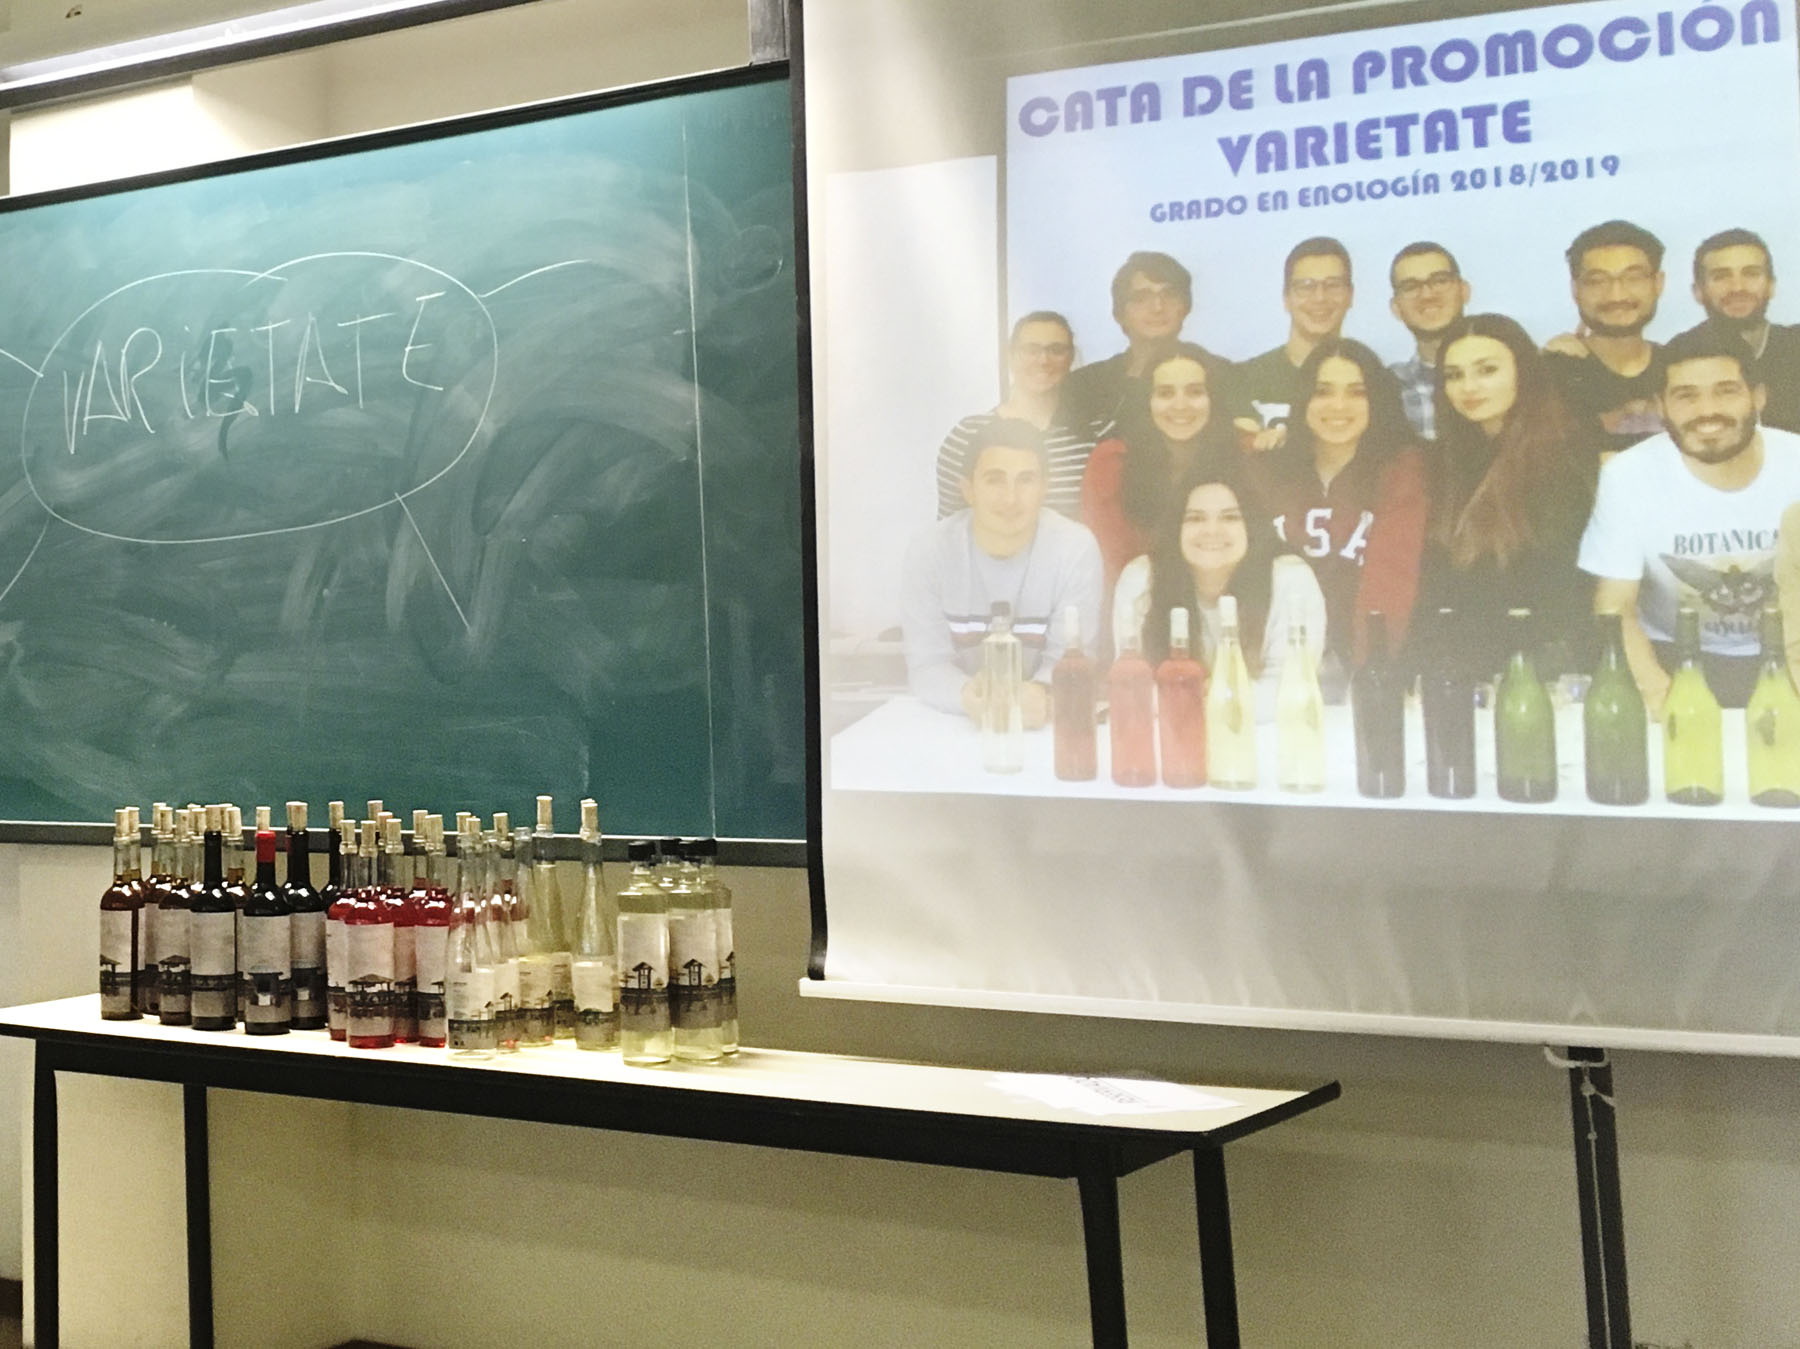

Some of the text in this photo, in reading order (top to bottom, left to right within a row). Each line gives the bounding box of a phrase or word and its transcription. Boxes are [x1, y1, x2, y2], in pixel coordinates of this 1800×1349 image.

[1018, 81, 1161, 138] CATA
[1182, 68, 1255, 118] DE
[1274, 57, 1331, 104] LA
[1216, 100, 1532, 177] VARIETATE
[1149, 155, 1621, 224] GRADO EN ENOLOGÍA 2018/2019
